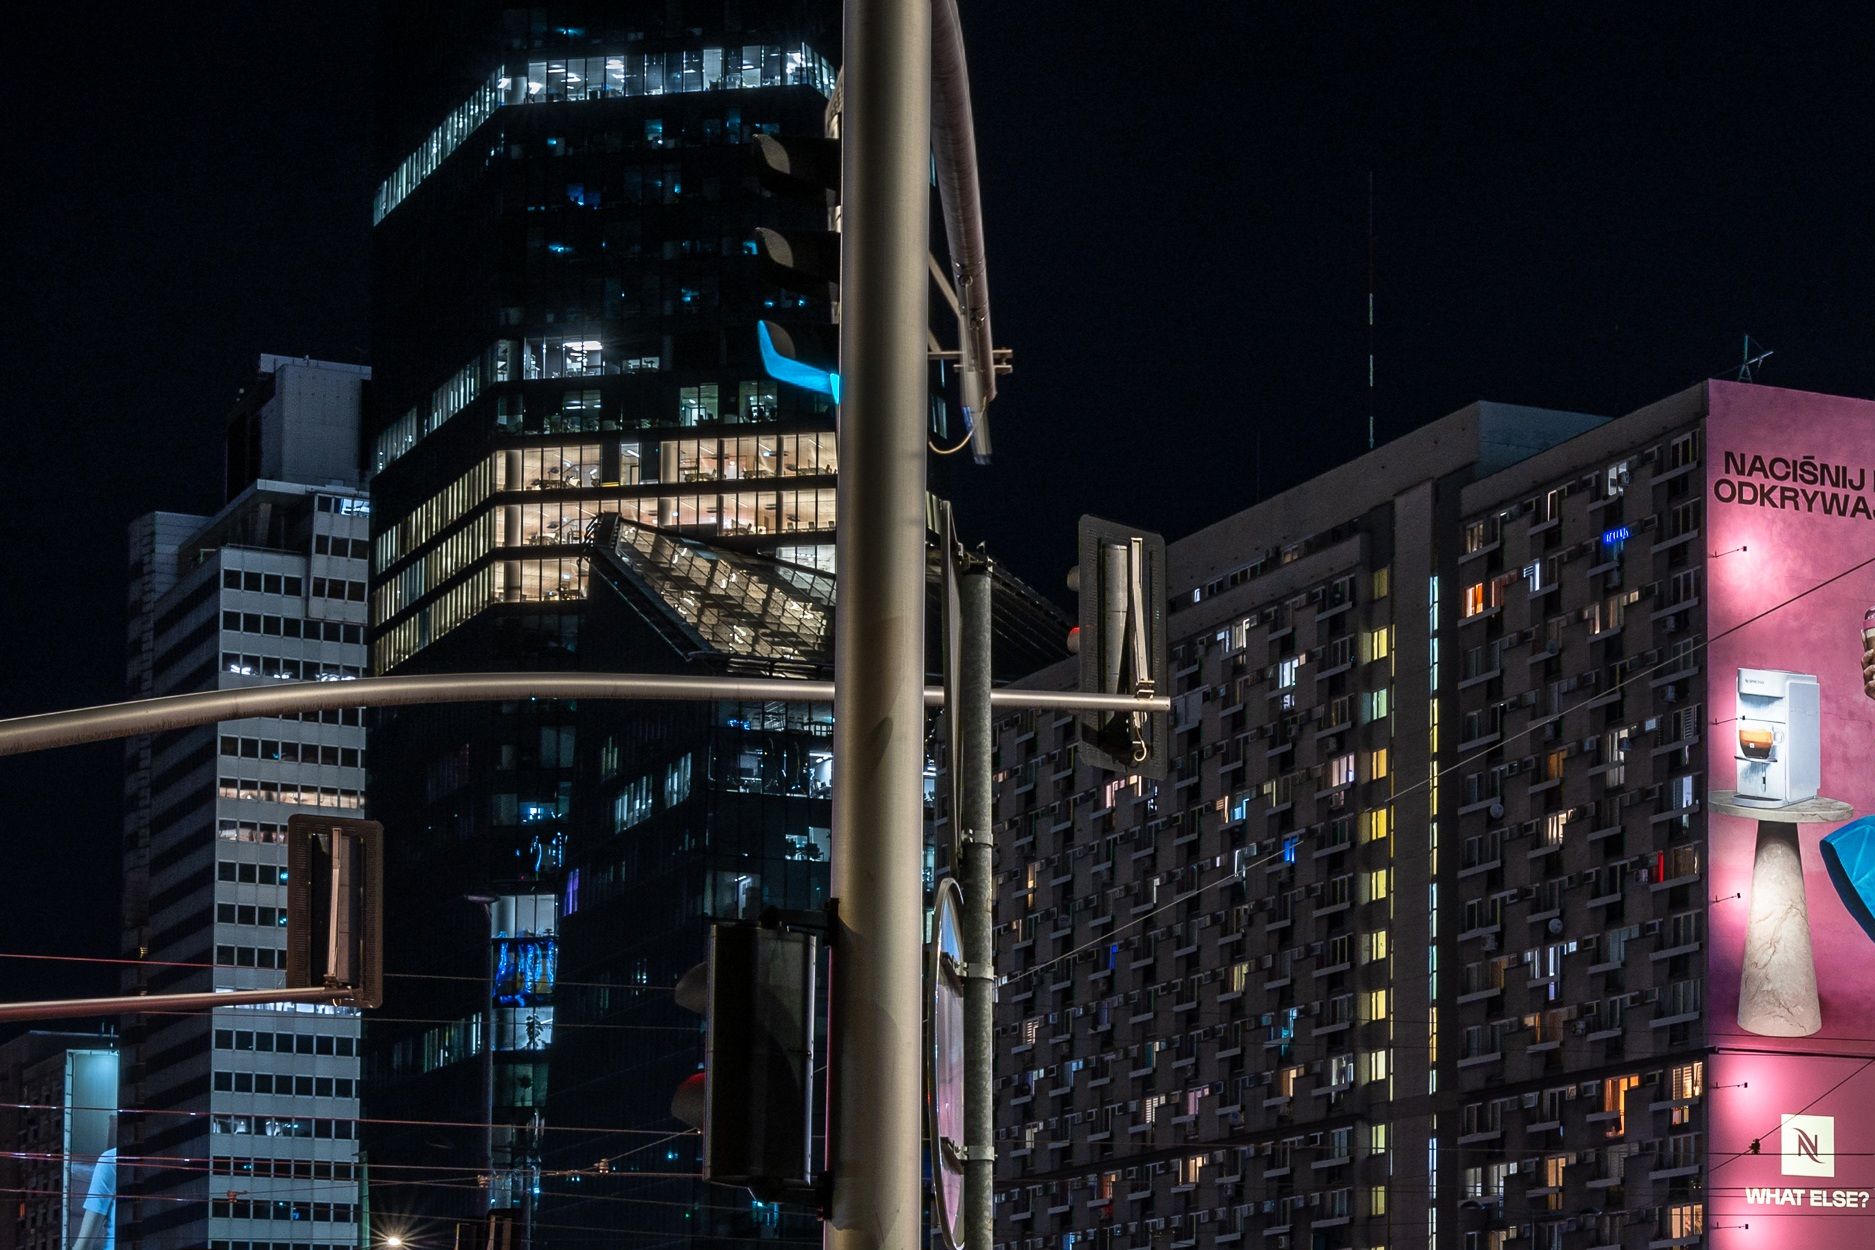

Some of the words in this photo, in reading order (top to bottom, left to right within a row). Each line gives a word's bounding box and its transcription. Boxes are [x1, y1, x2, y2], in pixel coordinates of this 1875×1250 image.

[1724, 451, 1866, 491] NACIŚNIJ
[1745, 1187, 1806, 1207] WHAT
[1809, 1189, 1870, 1208] ELSE?
